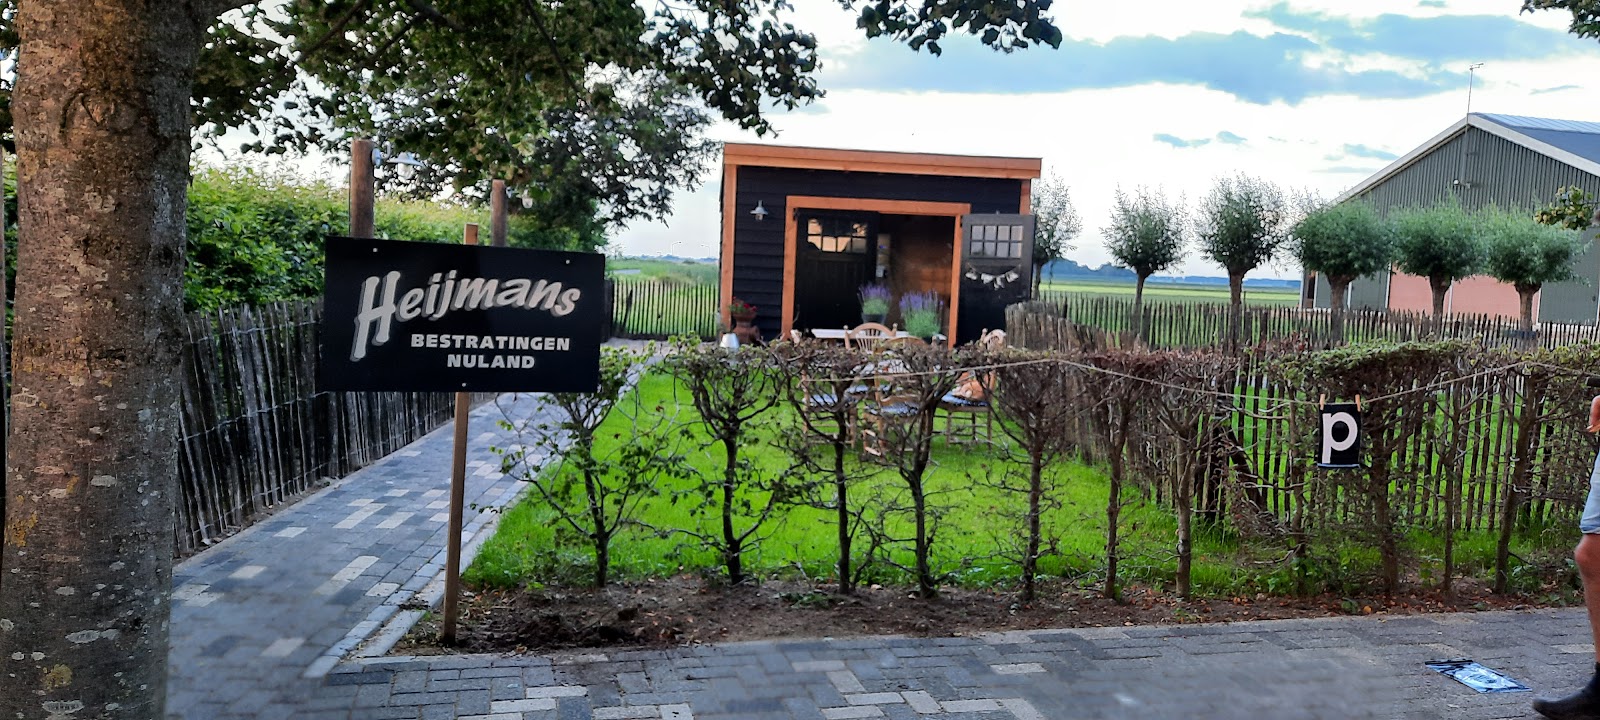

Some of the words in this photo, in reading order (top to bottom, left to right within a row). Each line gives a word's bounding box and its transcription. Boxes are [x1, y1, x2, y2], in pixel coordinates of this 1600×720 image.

[350, 270, 581, 362] Heijmans
[411, 333, 570, 351] BESTRATINGEN
[446, 354, 536, 369] NULAND
[1322, 412, 1358, 464] p
